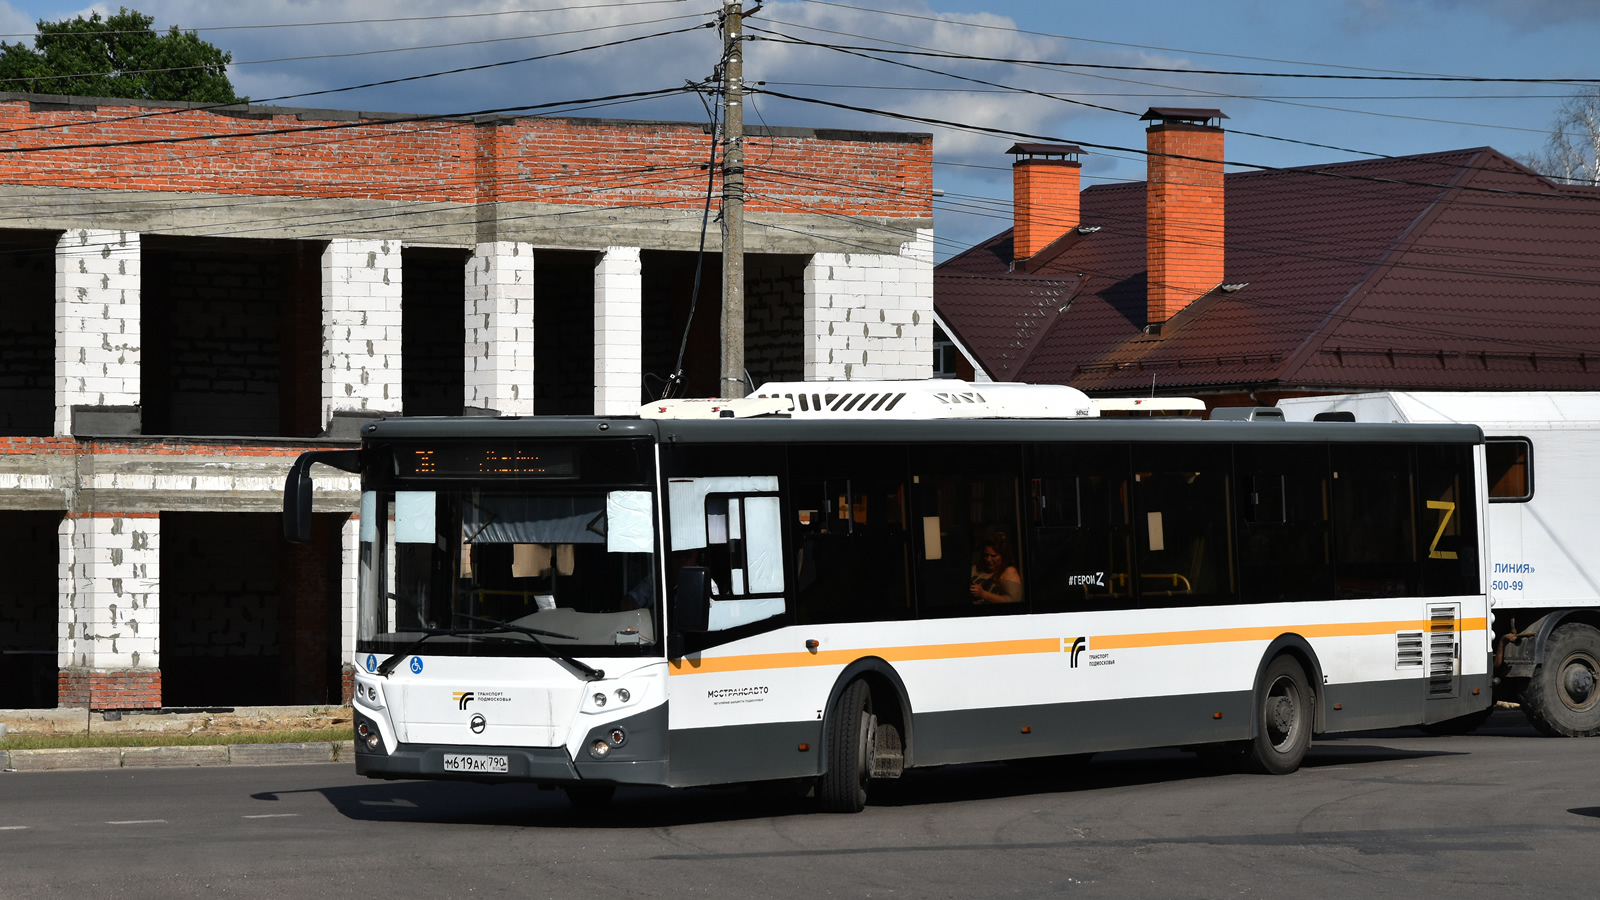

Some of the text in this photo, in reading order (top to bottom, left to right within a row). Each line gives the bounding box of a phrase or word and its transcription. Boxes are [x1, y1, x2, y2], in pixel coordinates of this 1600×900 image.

[1426, 500, 1458, 560] Z
[1494, 563, 1536, 574] ЛИНИЯ»
[707, 686, 769, 699] МОСТРАНСАВТО
